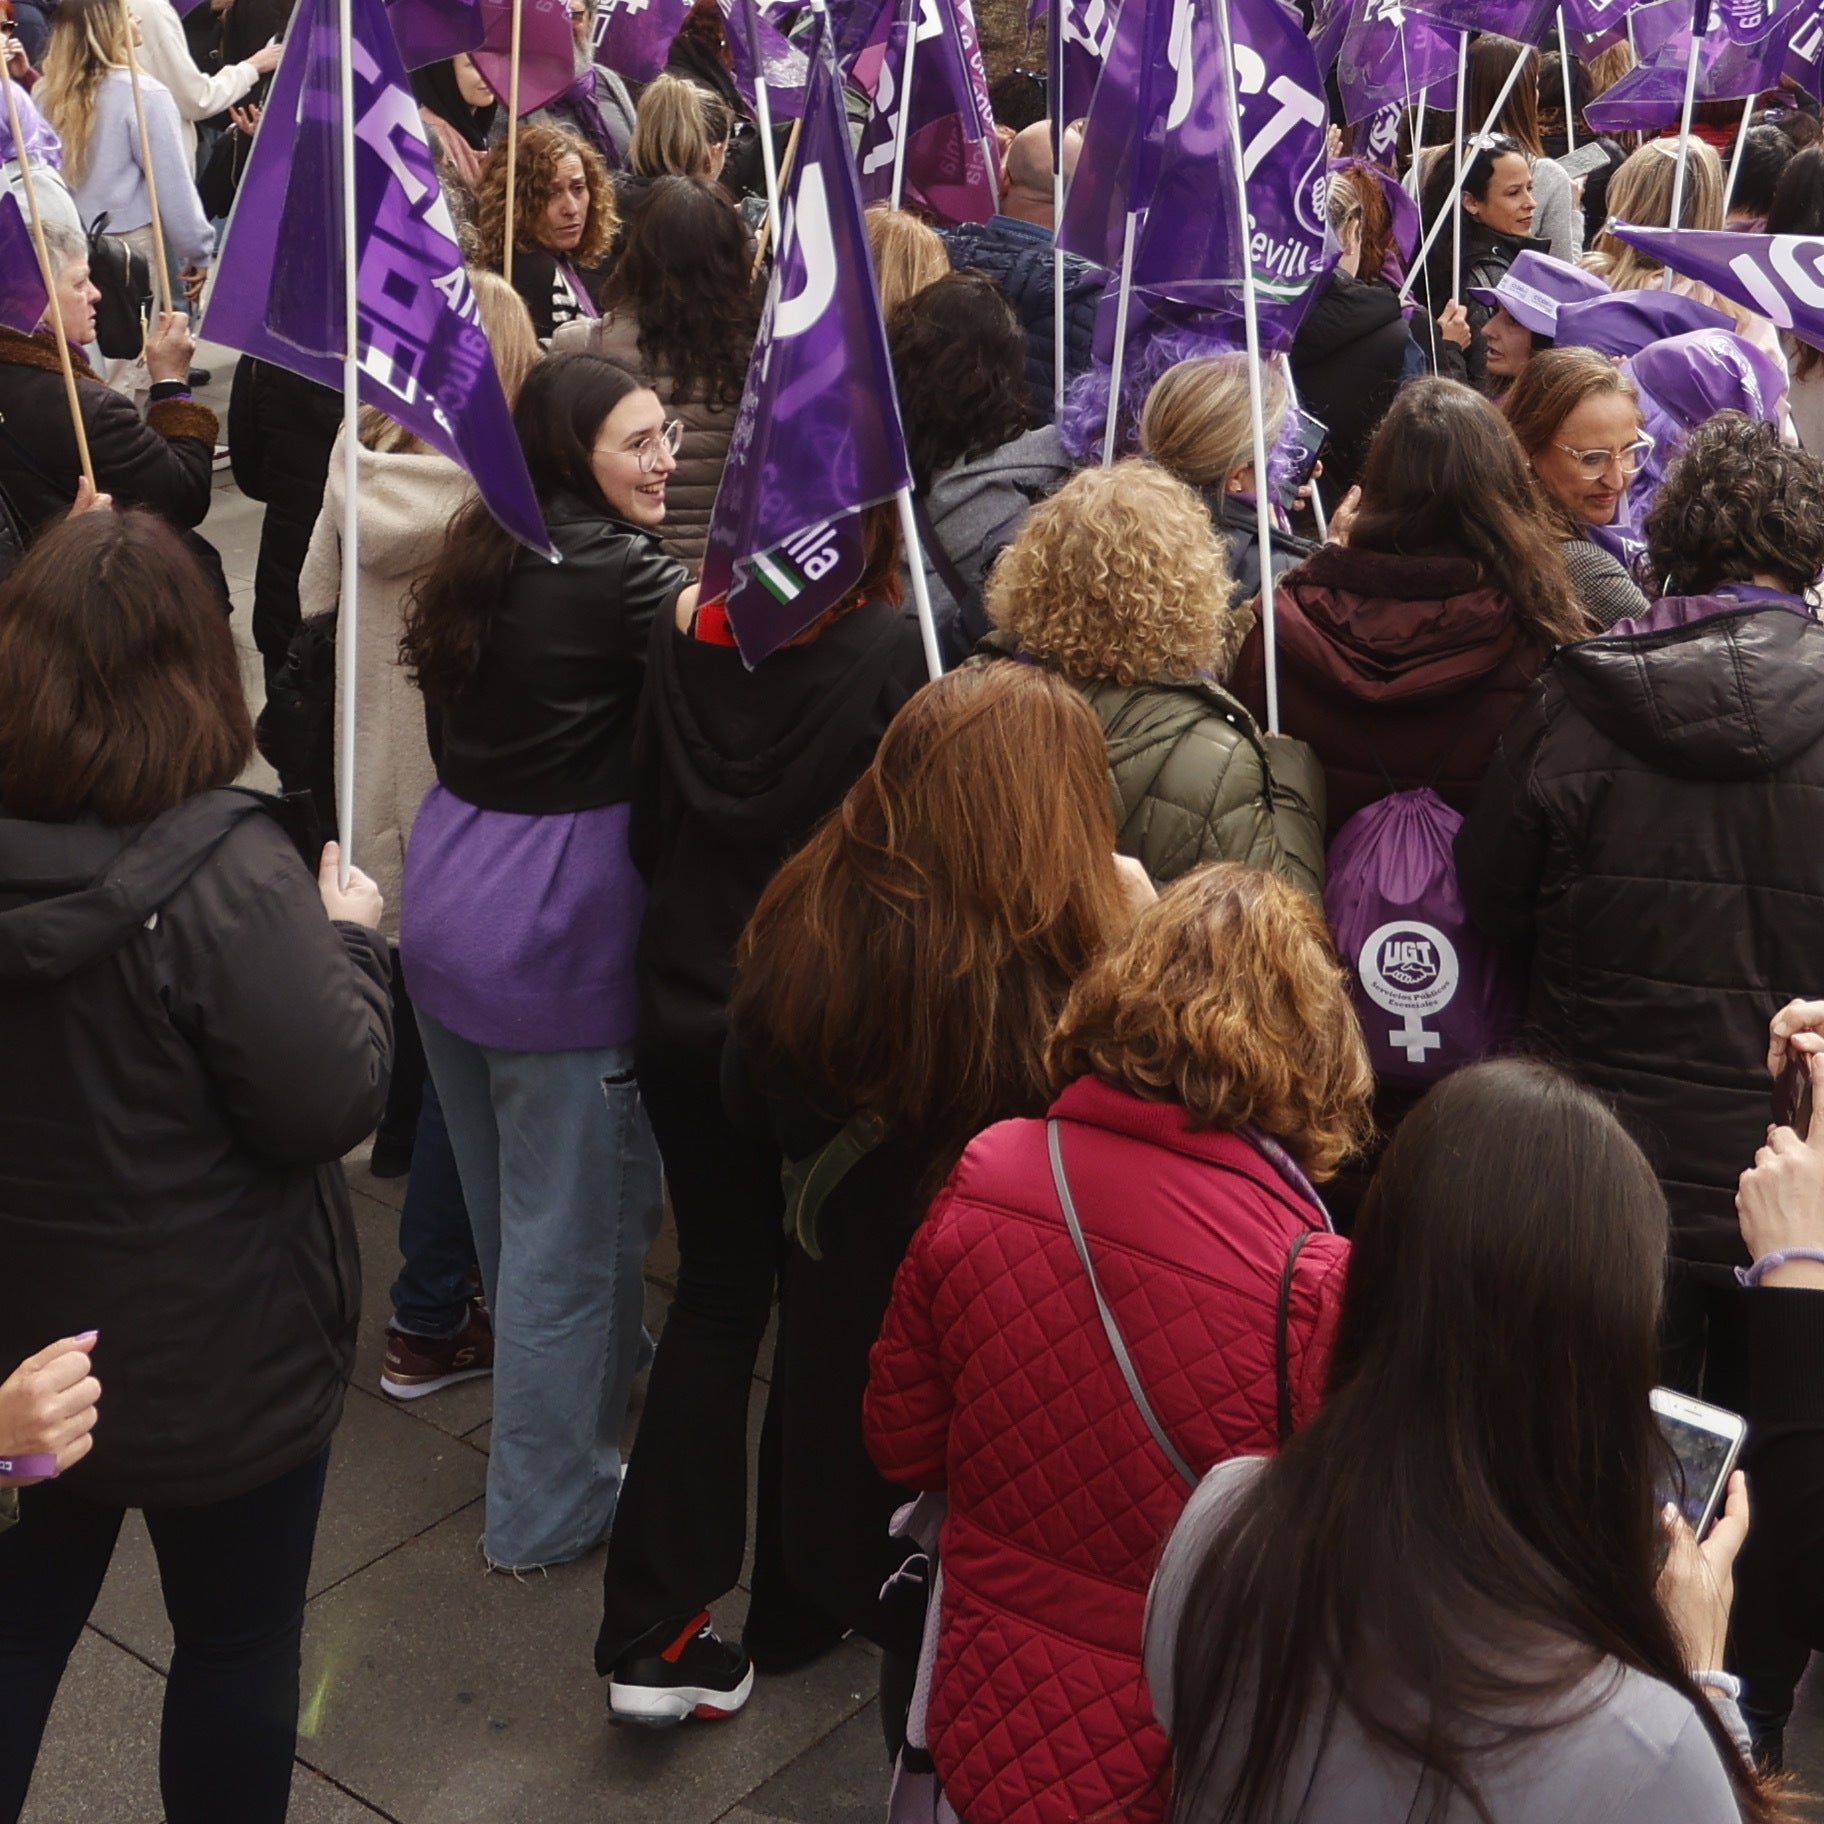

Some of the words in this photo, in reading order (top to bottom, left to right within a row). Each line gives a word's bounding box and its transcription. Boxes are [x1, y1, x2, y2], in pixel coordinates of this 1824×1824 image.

[1385, 941, 1432, 965] UGT
[1370, 980, 1413, 1002] Servicios
[1413, 980, 1451, 1002] Públicos
[1387, 998, 1439, 1009] Esenciales
